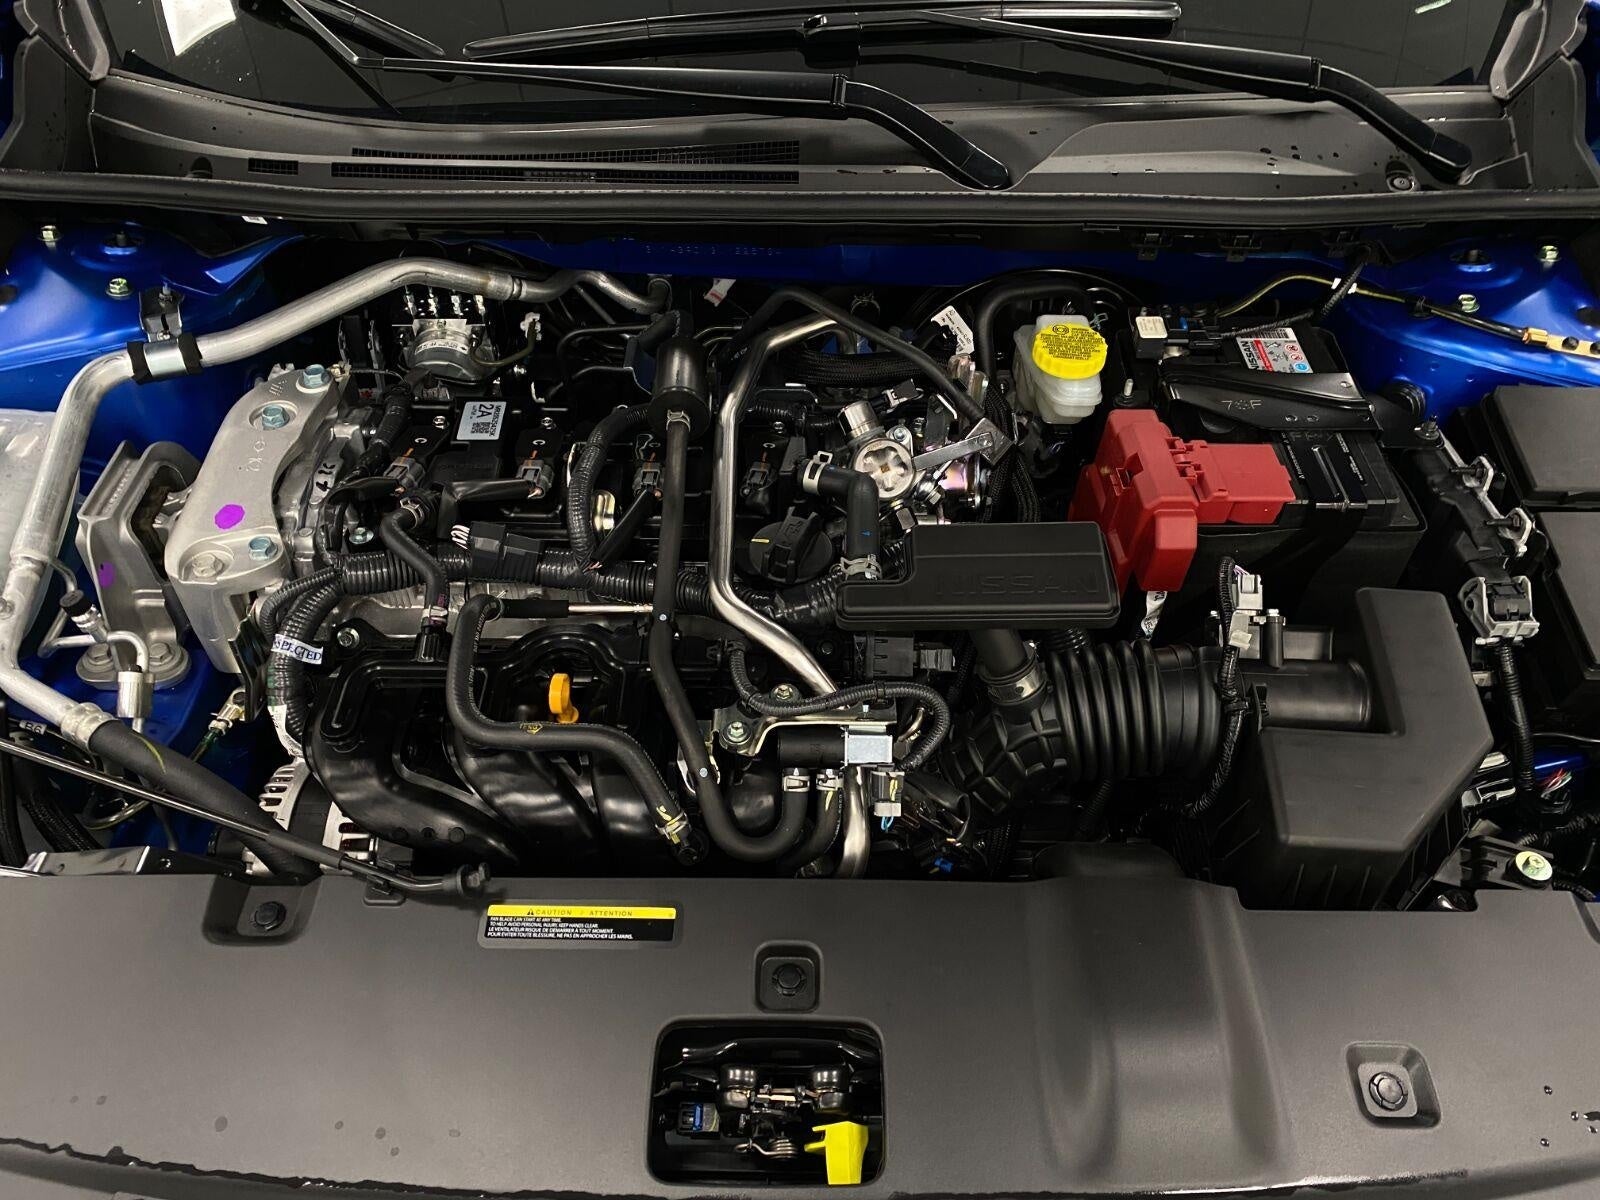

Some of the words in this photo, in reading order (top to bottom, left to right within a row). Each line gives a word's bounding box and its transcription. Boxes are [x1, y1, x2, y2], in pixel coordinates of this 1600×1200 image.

[477, 404, 494, 418] 2A
[935, 575, 1100, 596] NISSAN
[535, 908, 573, 916] CAUTION
